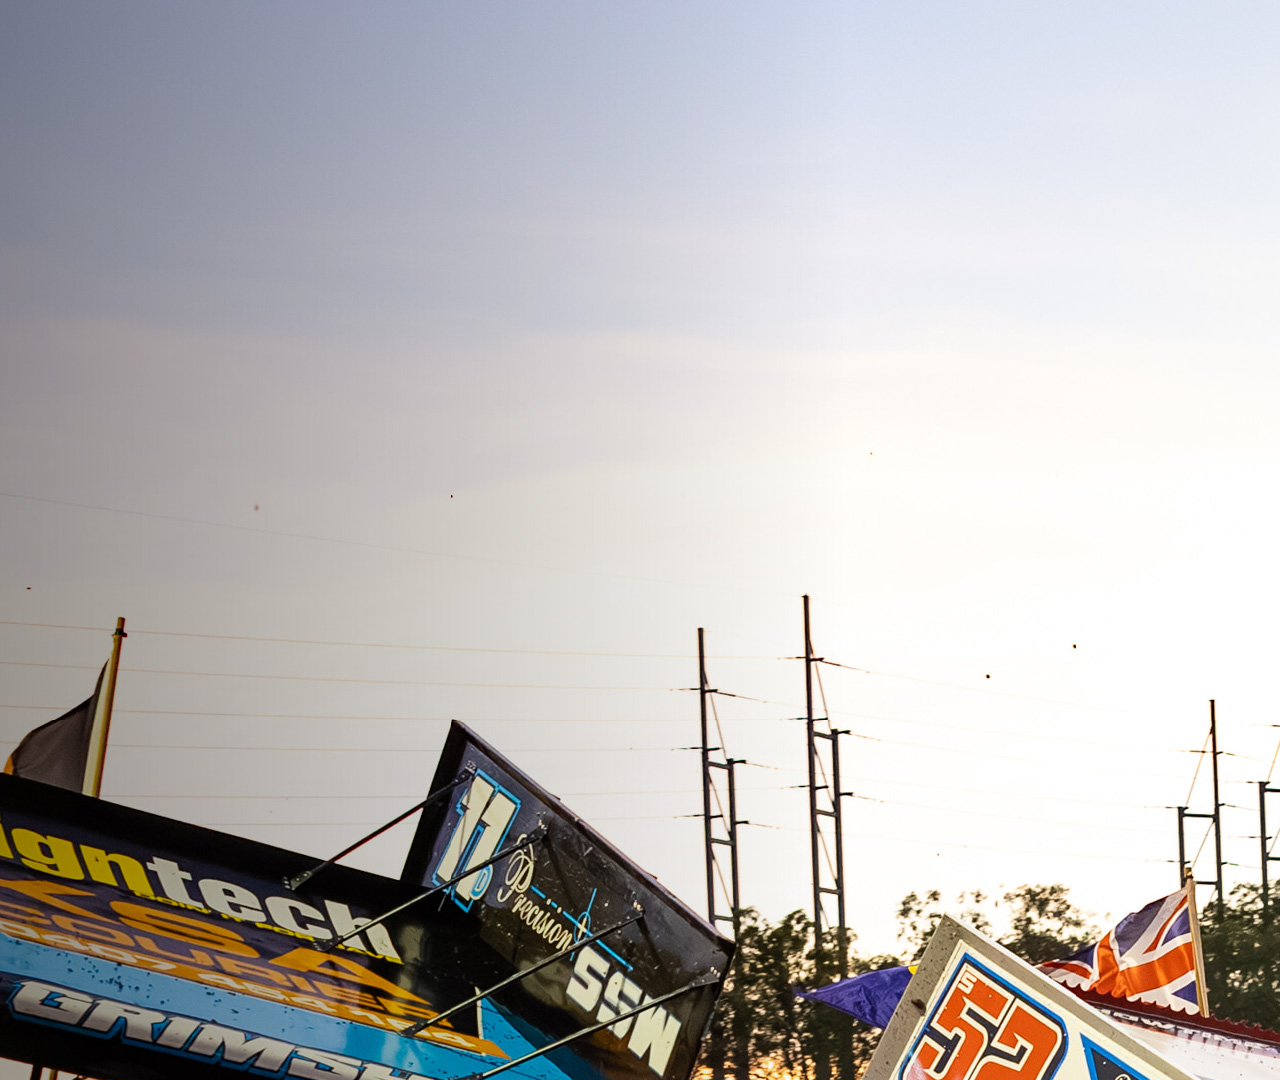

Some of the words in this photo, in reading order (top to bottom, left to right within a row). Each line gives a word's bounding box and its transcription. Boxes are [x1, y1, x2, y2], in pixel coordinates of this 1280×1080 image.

[434, 773, 520, 903] 11
[497, 833, 575, 952] Precision
[566, 944, 683, 1079] SSW
